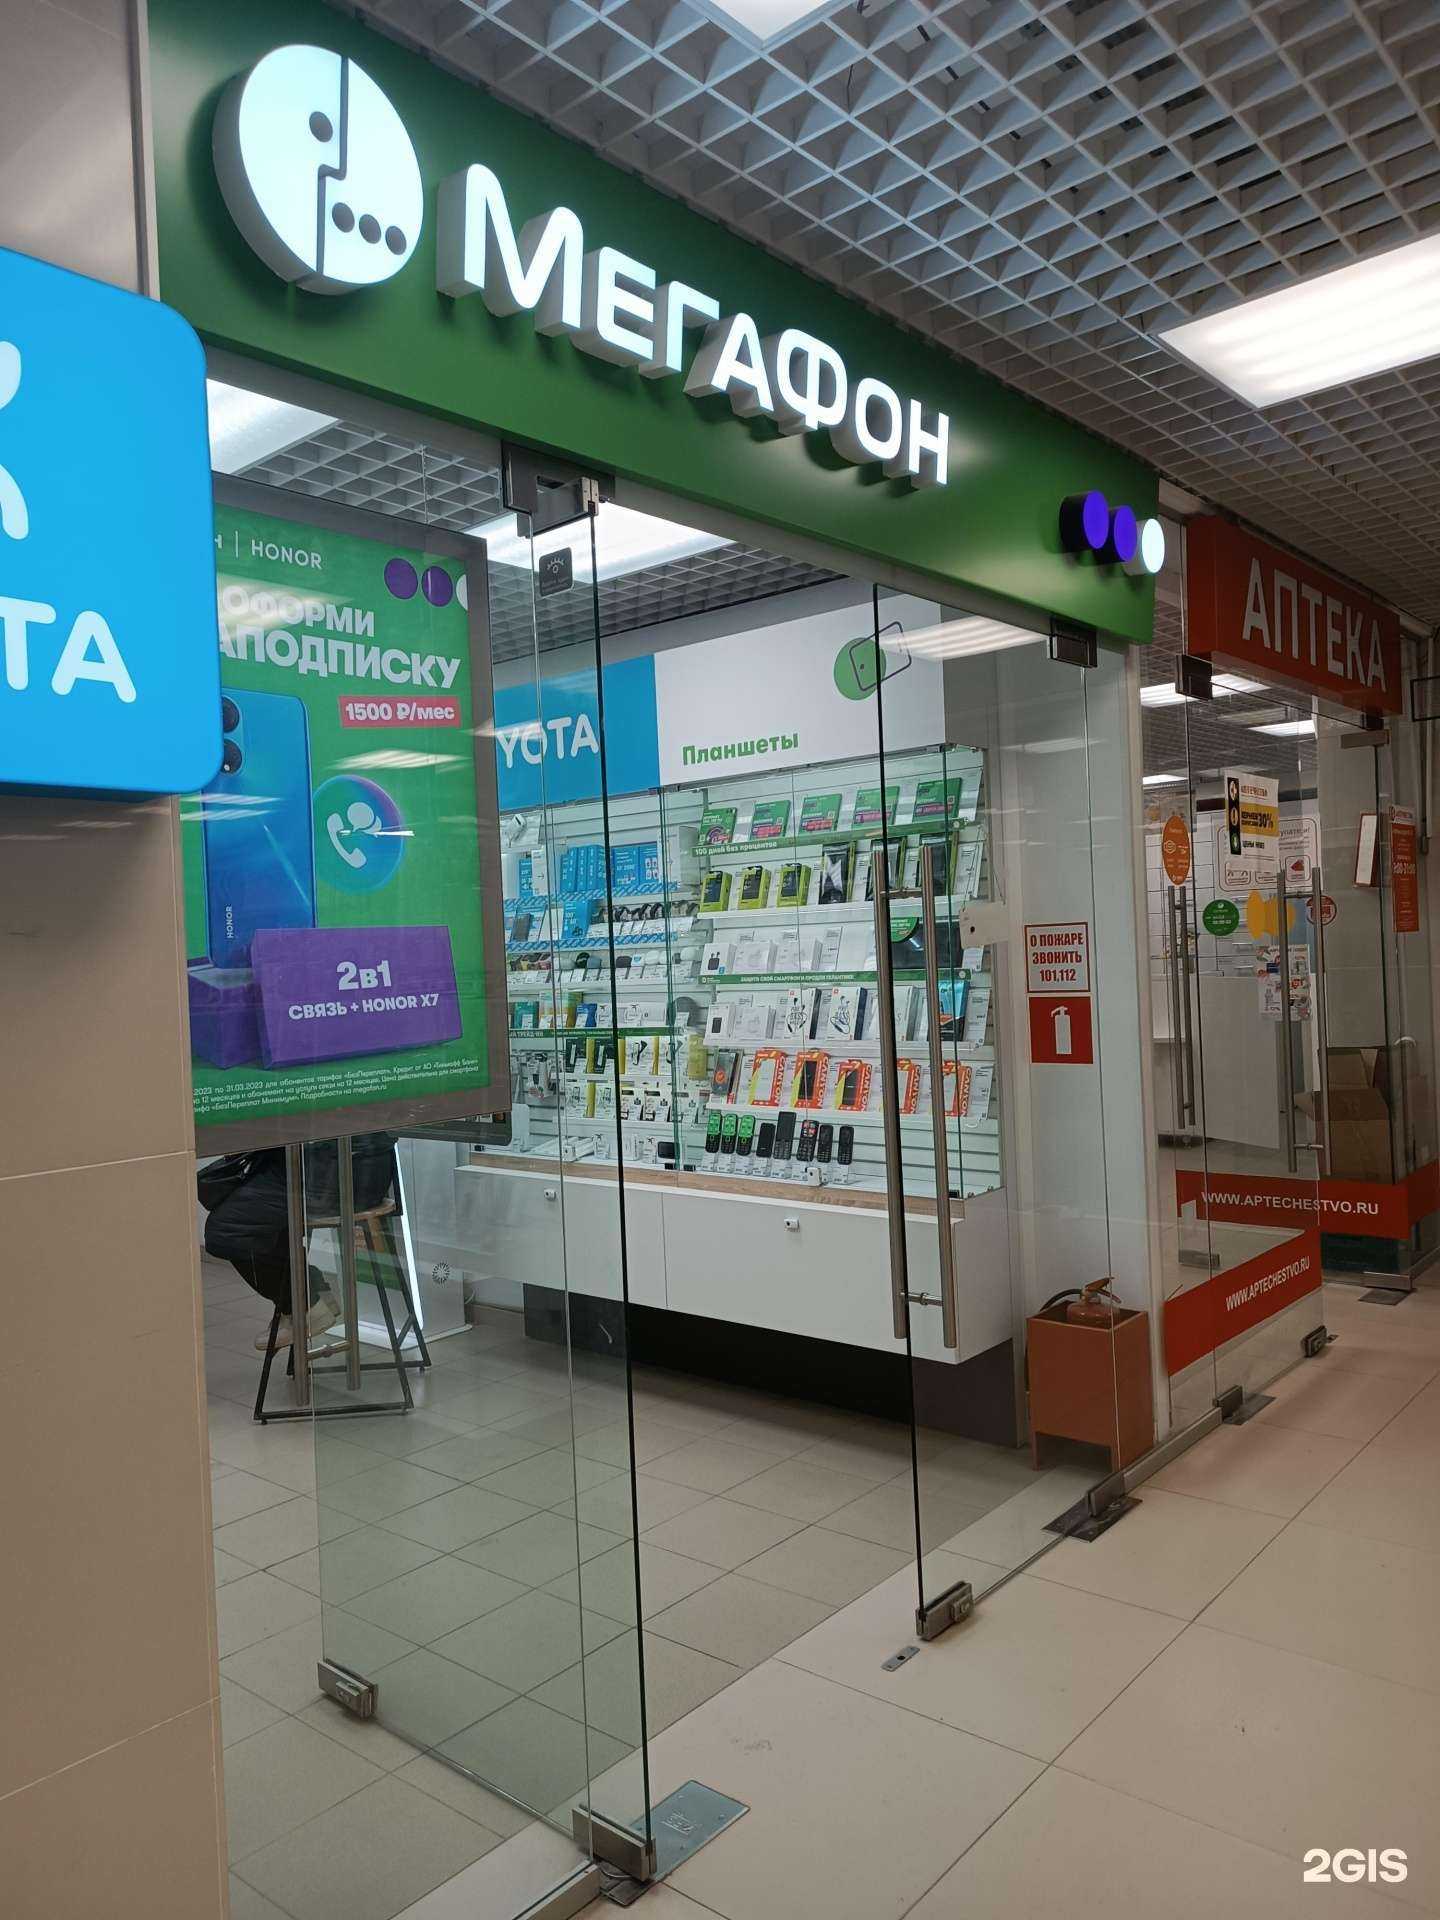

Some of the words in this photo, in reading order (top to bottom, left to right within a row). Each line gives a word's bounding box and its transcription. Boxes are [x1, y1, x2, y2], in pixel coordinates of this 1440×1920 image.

[464, 163, 950, 487] МЕГАФОН
[251, 539, 322, 569] HONOR
[223, 585, 375, 637] ОФОРМИ
[1242, 557, 1386, 693] АПТЕКА
[346, 703, 393, 721] 1500
[396, 703, 455, 721] ₽/мес
[496, 713, 600, 769] YOTA
[682, 729, 800, 766] Планшеты
[1030, 934, 1038, 947] О
[1040, 932, 1084, 947] ПОЖАРЕ
[1032, 951, 1082, 965] ЗВОНИТЬ
[336, 959, 392, 991] 2в1
[288, 1001, 347, 1020] СВЯЗЬ
[350, 1002, 359, 1012] +
[362, 995, 418, 1013] HONOR
[420, 993, 439, 1008] X7
[1201, 1191, 1379, 1215] WWW.APTECHESTVO.RU
[1225, 1256, 1310, 1311] WWW.APTECHESTVO.RU
